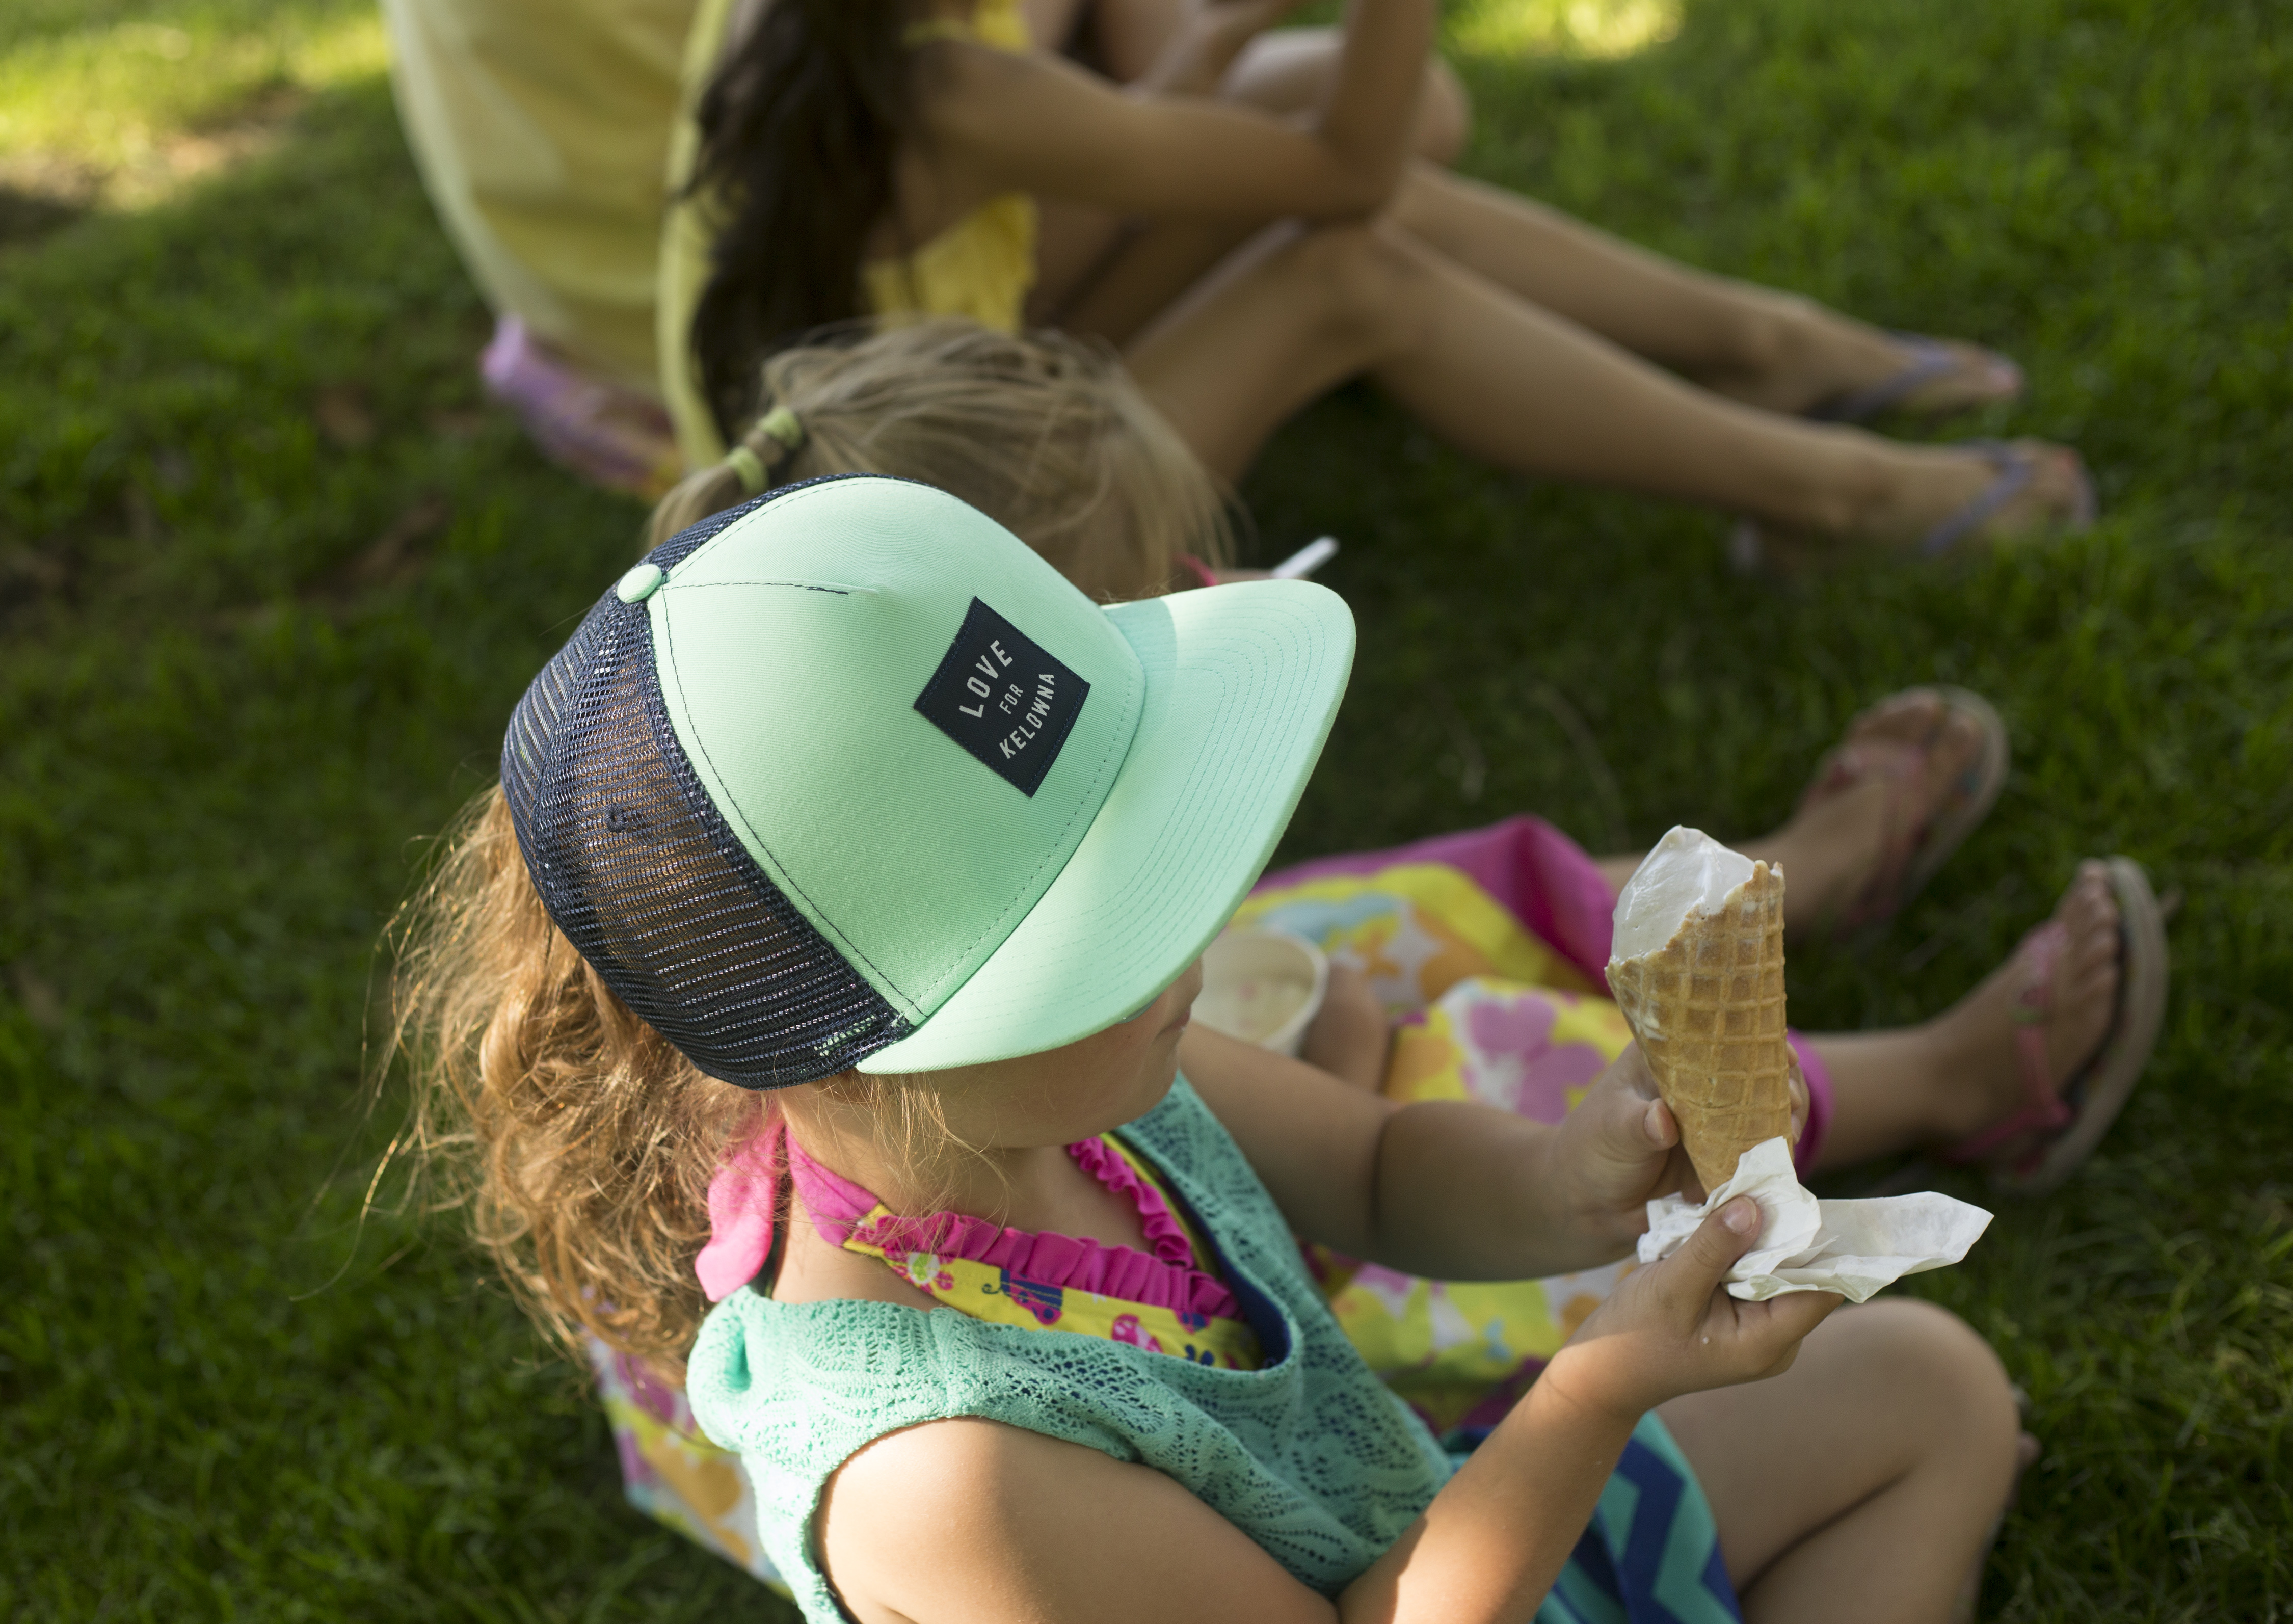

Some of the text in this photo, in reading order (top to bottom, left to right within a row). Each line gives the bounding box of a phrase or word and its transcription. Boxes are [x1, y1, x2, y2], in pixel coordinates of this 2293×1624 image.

[959, 640, 1012, 717] LOVE
[999, 684, 1023, 714] FOR
[999, 674, 1054, 759] KELOWNA
